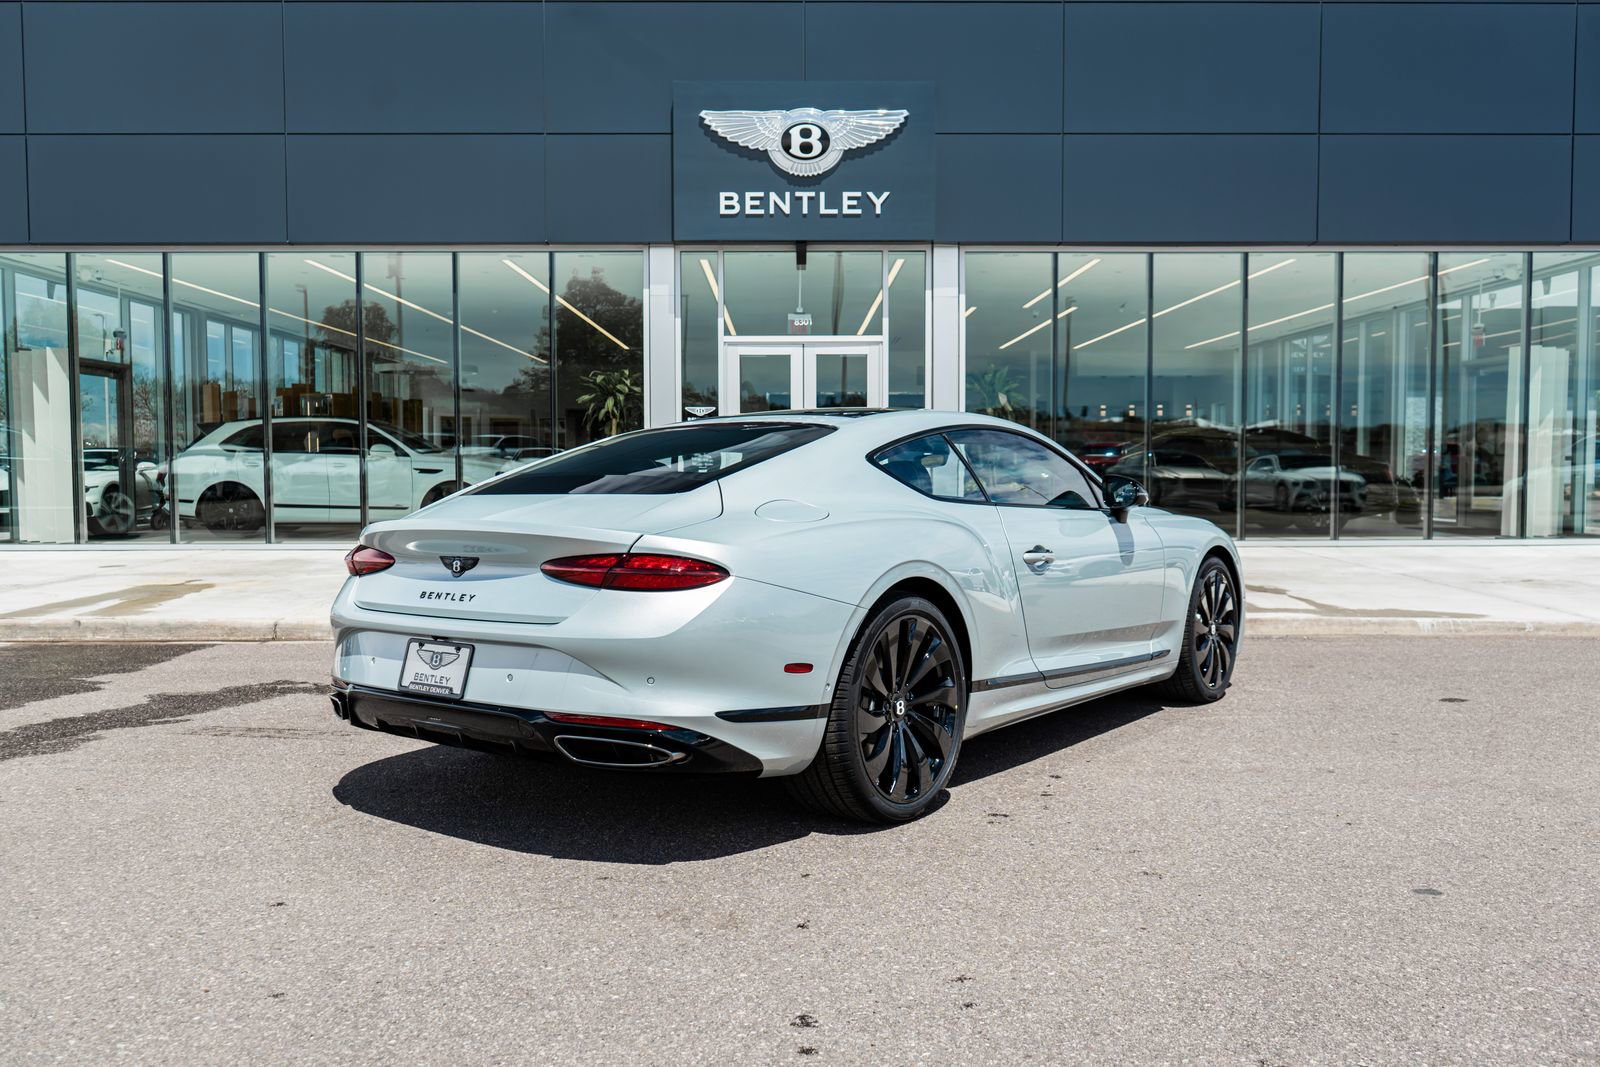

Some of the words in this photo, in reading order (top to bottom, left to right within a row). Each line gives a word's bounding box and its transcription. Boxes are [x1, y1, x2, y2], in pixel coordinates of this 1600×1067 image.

[789, 124, 823, 158] B
[719, 191, 891, 215] BENTLEY
[420, 591, 476, 602] BENTLEY
[414, 672, 451, 685] BENTLEY
[409, 683, 430, 692] BENTLEY
[429, 686, 450, 695] DENVER
